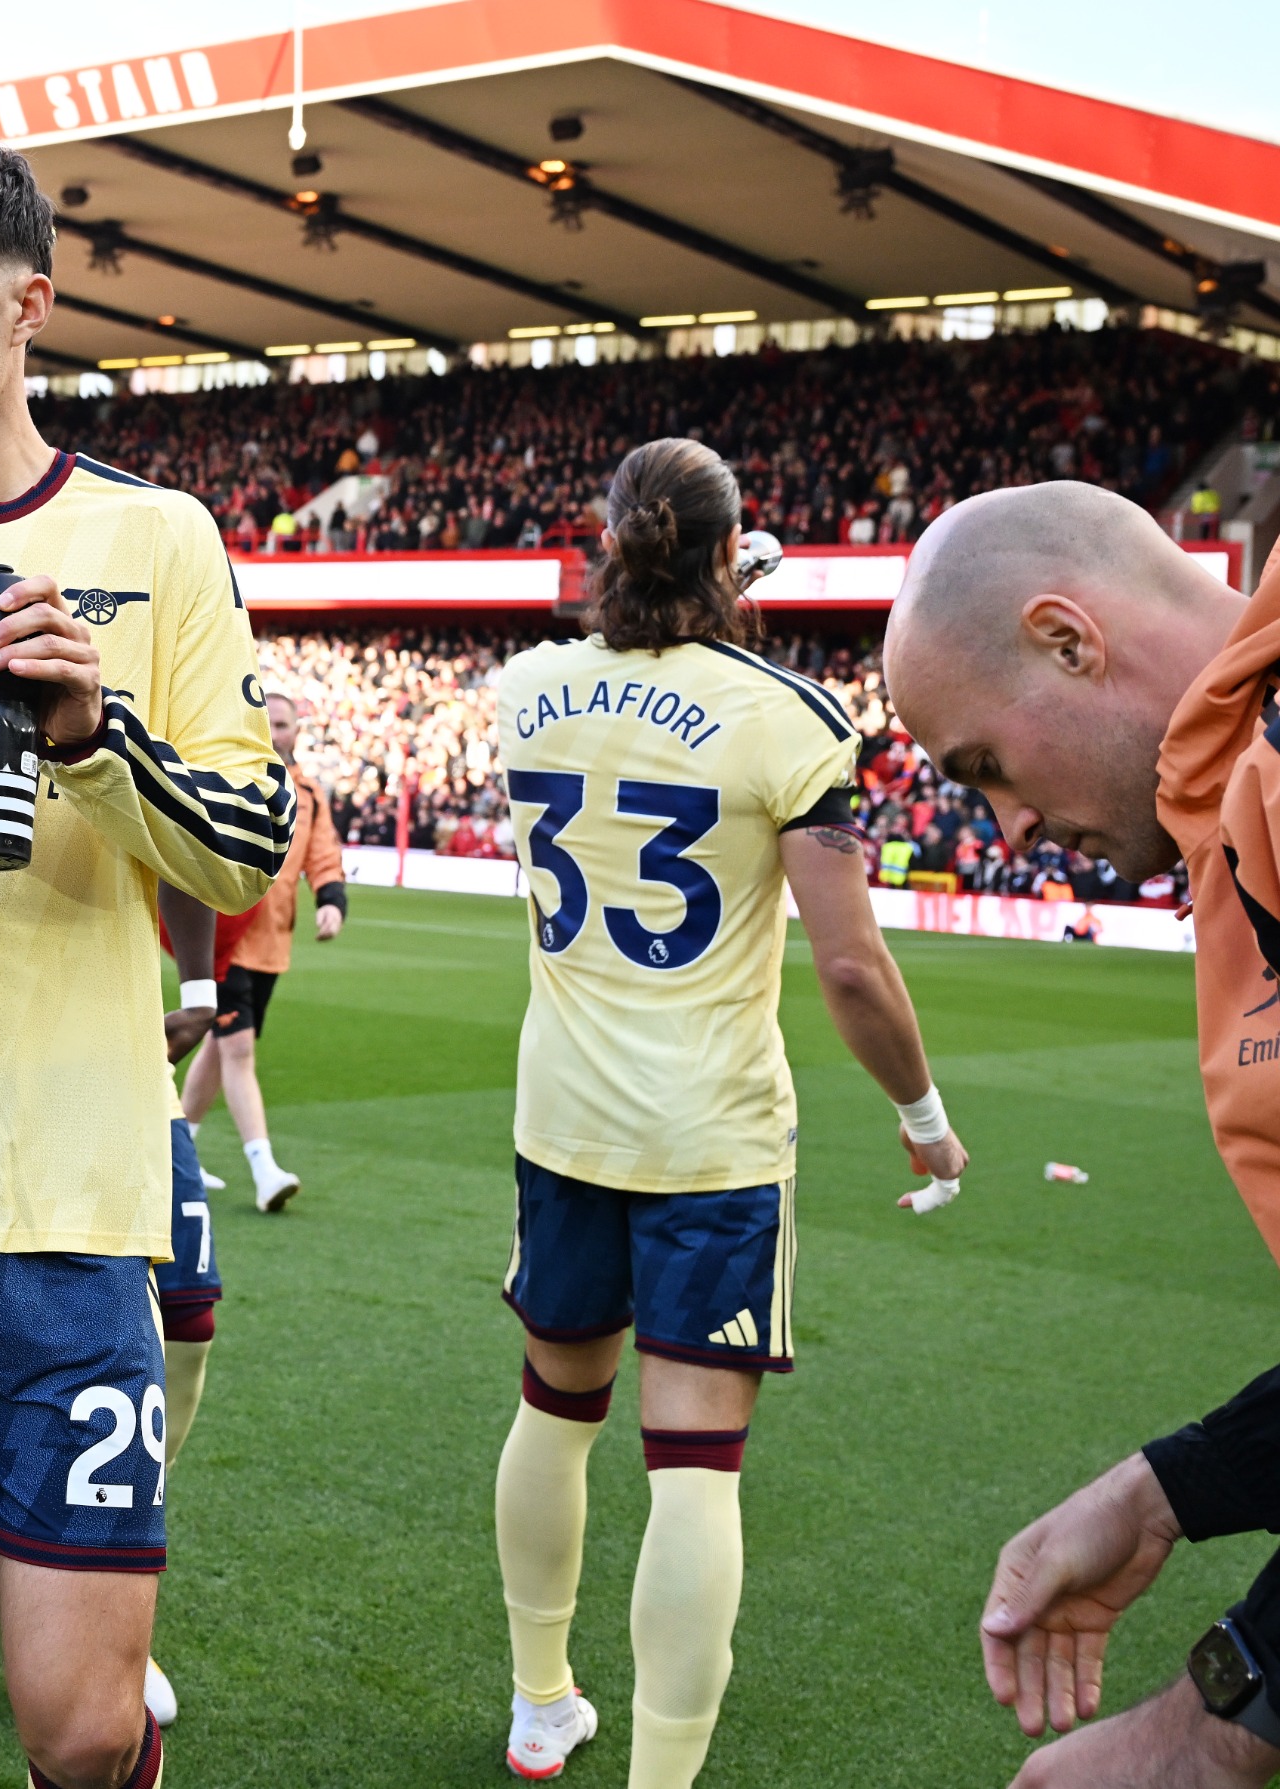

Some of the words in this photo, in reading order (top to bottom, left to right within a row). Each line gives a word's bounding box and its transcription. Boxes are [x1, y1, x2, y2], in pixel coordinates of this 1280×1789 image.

[45, 51, 218, 129] STAND
[515, 681, 721, 750] CALAFIORI
[507, 768, 722, 971] 33
[181, 1201, 210, 1274] 7
[66, 1383, 166, 1508] 29
